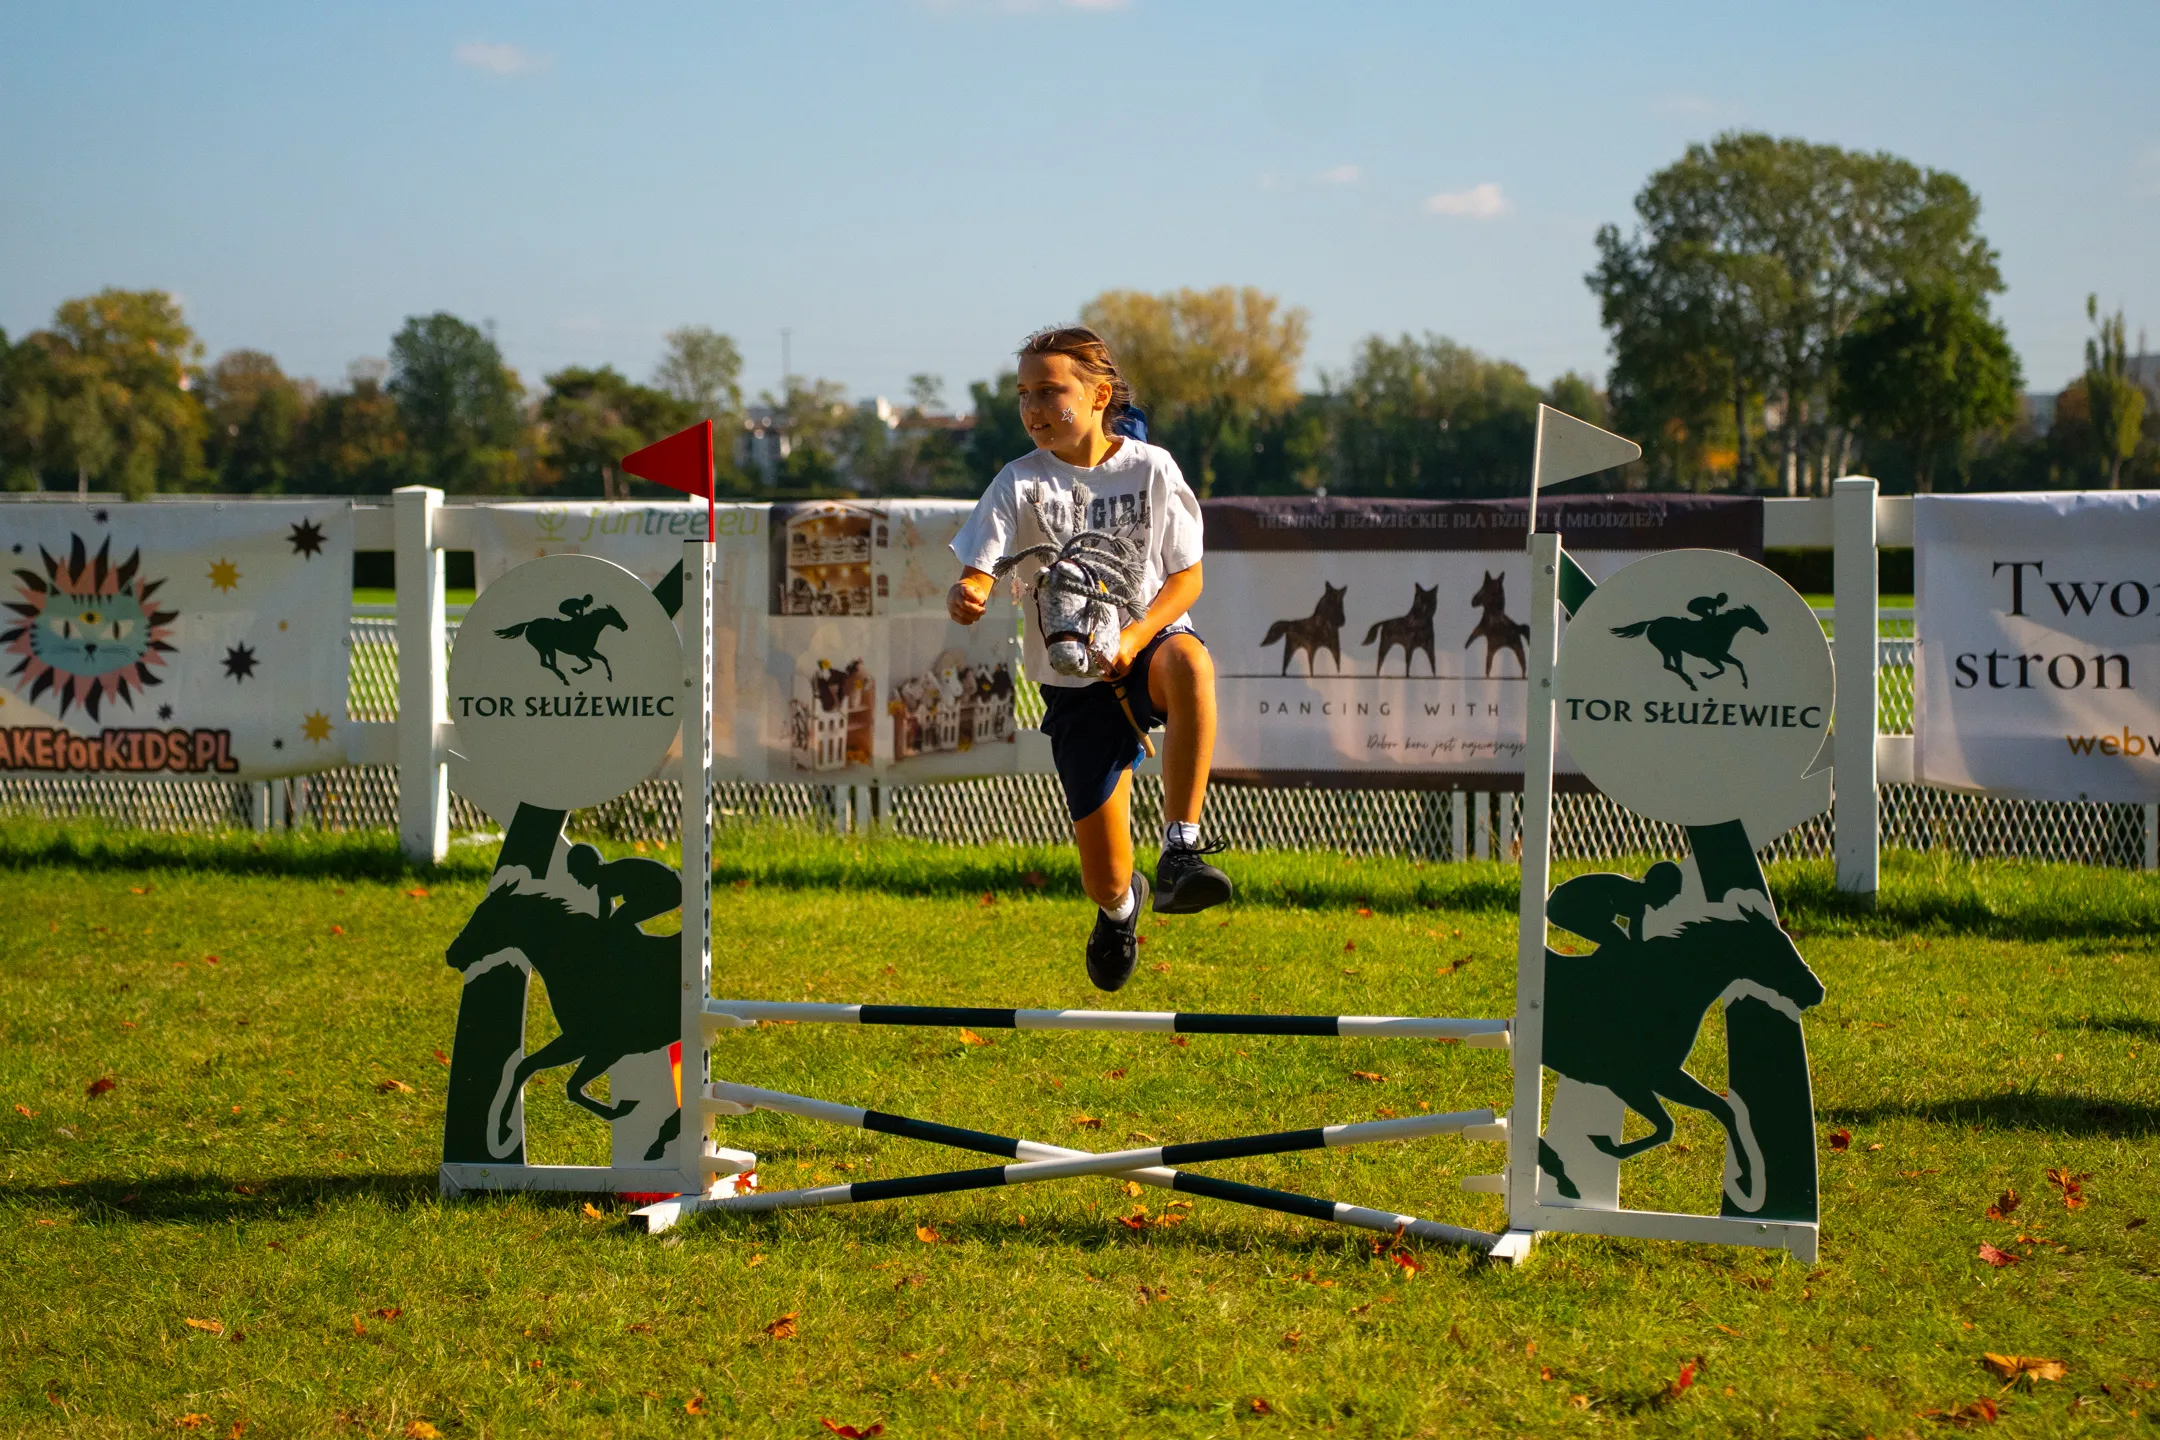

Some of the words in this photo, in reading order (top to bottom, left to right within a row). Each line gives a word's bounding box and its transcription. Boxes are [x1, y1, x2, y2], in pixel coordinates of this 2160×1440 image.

[1257, 513, 1337, 530] TRENINGI
[1453, 512, 1488, 530] DLA
[1992, 560, 2160, 618] Two
[1955, 649, 2134, 689] stron
[458, 696, 517, 718] TOR
[525, 691, 675, 718] SŁUŻEWIEC
[1260, 701, 1391, 717] DANCING
[1425, 702, 1499, 718] WITH
[1566, 698, 1633, 723] TOR
[1644, 697, 1821, 729] SŁUŻEWIEC
[1431, 736, 1457, 757] jest
